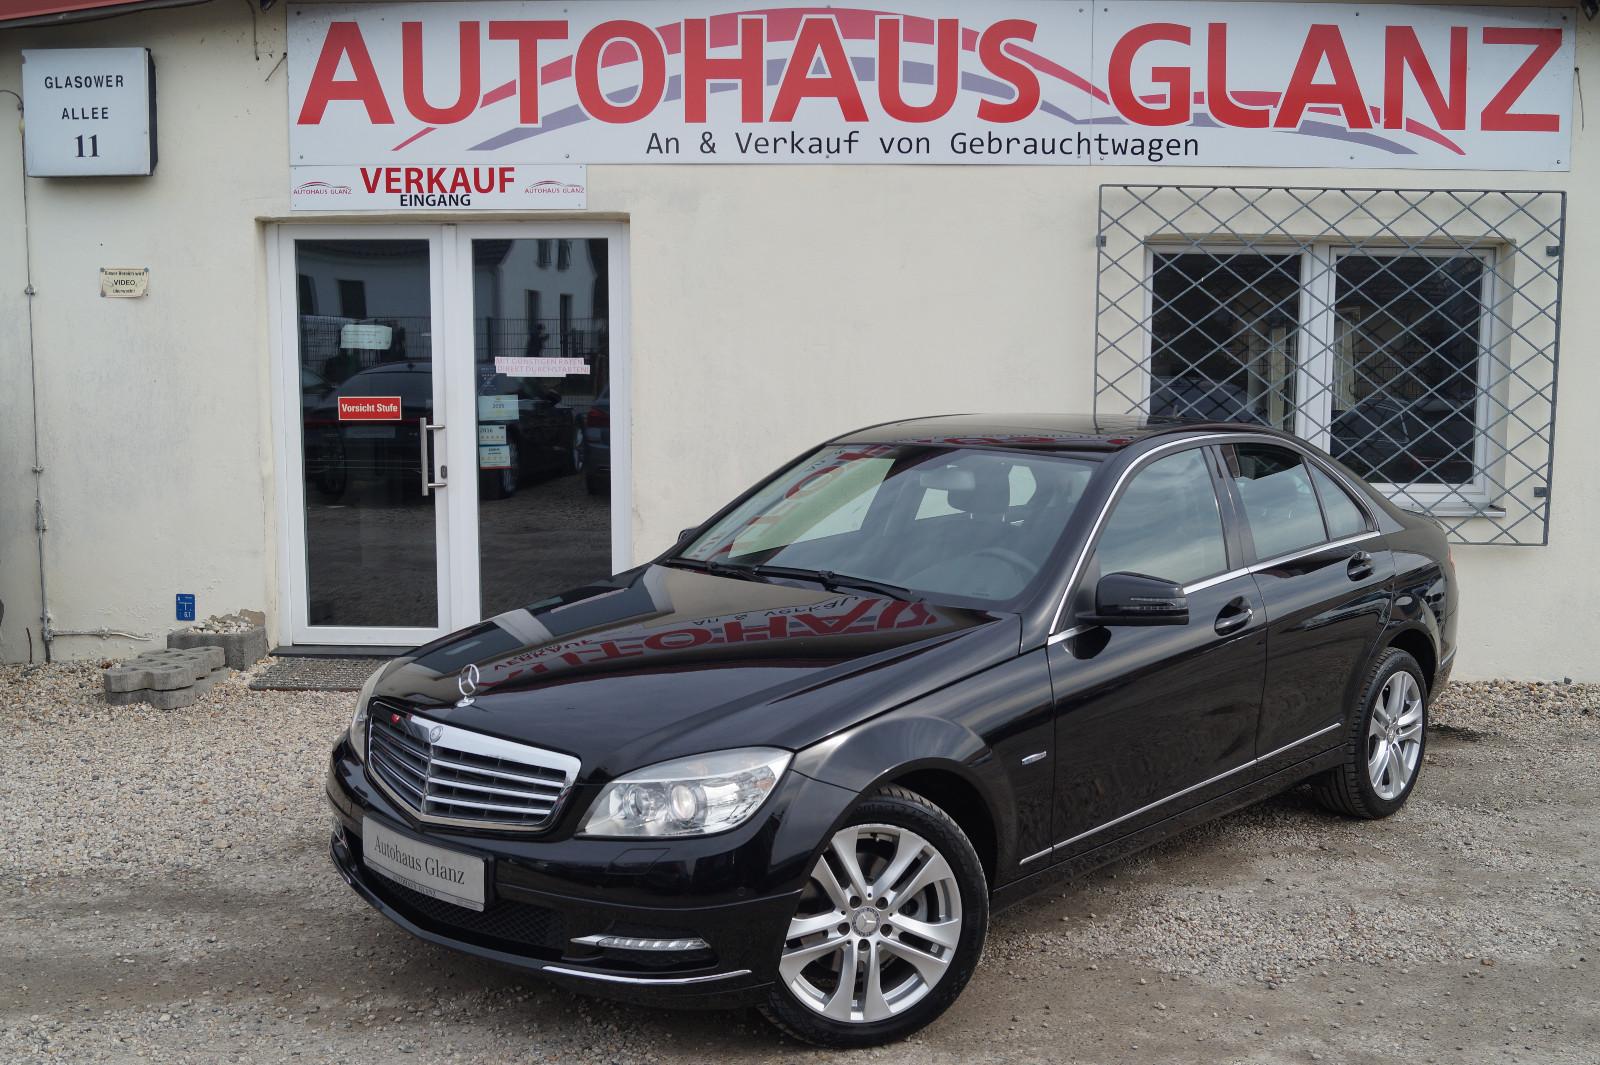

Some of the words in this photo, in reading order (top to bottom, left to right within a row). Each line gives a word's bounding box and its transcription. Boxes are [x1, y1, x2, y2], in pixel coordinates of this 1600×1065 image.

[44, 74, 124, 89] GLASOWER
[298, 19, 1041, 127] AUTOHAUS
[1107, 22, 1563, 133] GLANZ
[61, 107, 109, 120] ALLEE
[74, 134, 100, 158] 11
[646, 131, 681, 154] An
[699, 131, 717, 154] &
[735, 130, 860, 154] Verkauf
[879, 136, 931, 154] von
[950, 130, 1199, 162] Gebrauchtwagen
[360, 167, 515, 194] VERKAUF
[399, 194, 471, 207] EINGANG
[341, 403, 375, 413] Vorsicht
[376, 403, 398, 413] Stufe
[374, 834, 422, 872] Autohaus
[424, 857, 466, 885] Glanz
